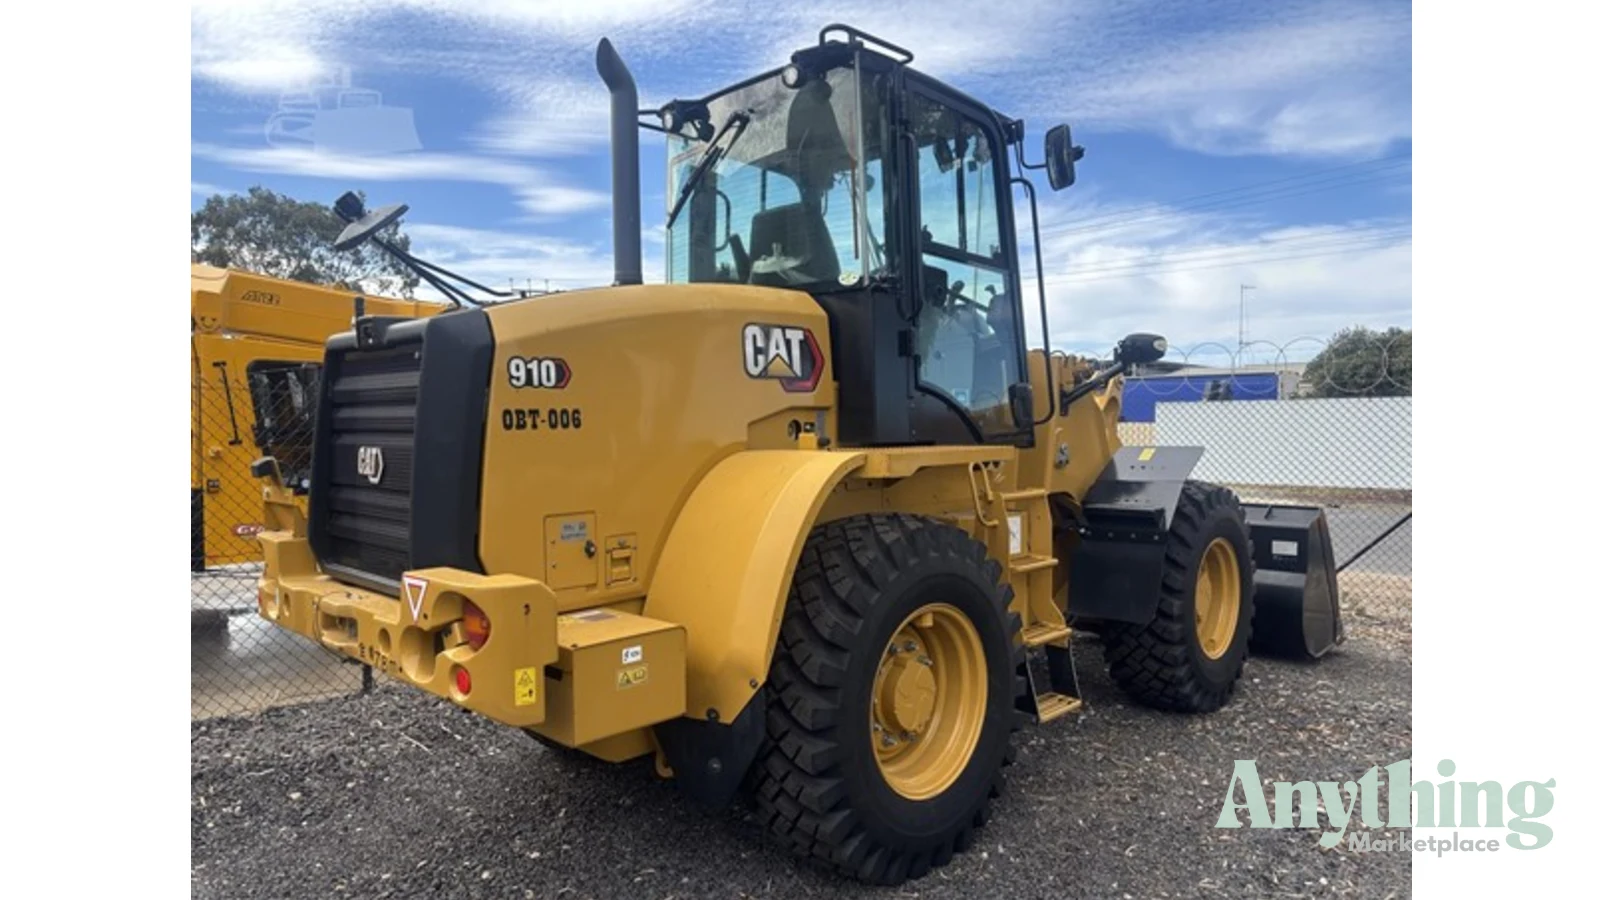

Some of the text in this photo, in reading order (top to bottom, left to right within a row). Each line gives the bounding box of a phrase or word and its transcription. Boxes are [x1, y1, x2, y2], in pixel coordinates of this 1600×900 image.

[744, 324, 804, 378] CAT
[508, 357, 556, 388] 910
[502, 408, 582, 431] OBT-006
